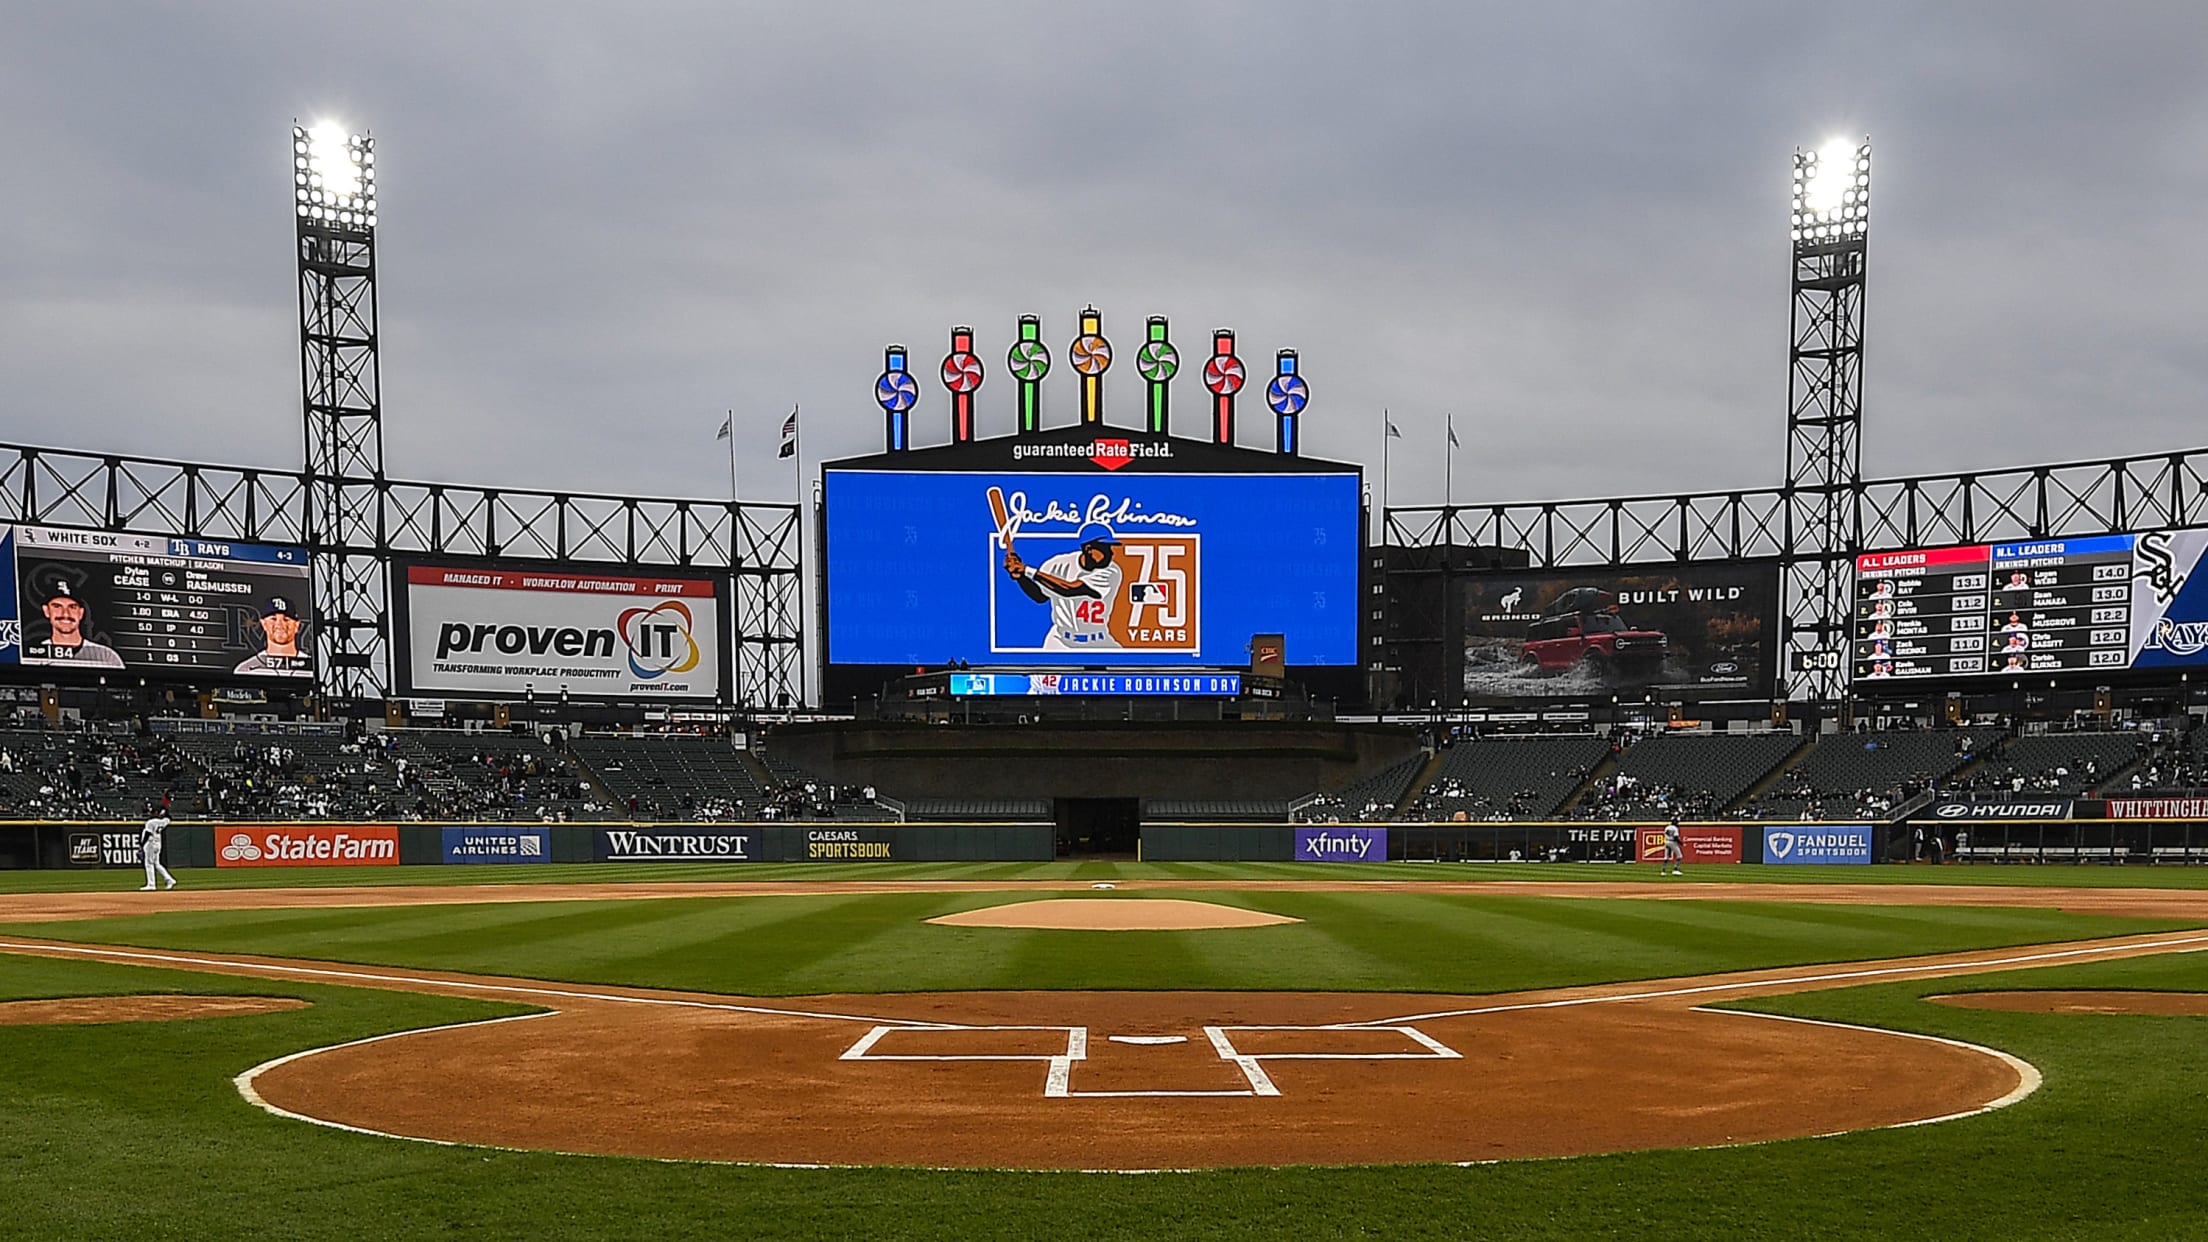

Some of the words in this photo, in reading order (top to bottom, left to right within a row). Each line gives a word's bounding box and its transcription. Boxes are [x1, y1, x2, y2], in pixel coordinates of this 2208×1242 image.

[1013, 443, 1094, 459] guaranteed
[1095, 442, 1128, 457] Rate
[1129, 442, 1174, 457] Field.
[1000, 492, 1081, 548] Jackie
[1085, 494, 1197, 526] Robinson
[48, 531, 88, 544] WHITE
[92, 535, 117, 547] SOX
[134, 540, 150, 549] 4-2
[197, 543, 229, 555] RAYS
[2018, 543, 2065, 555] LEADERS
[110, 554, 145, 564] PITCHER
[146, 557, 186, 567] MATCHUP
[194, 561, 224, 570] SEASON
[277, 552, 293, 561] 4-3
[1883, 554, 1926, 566] LEADERS
[2031, 557, 2064, 567] PITCHED
[124, 567, 149, 576] Dylan
[1894, 567, 1926, 577] PITCHED
[2099, 568, 2125, 578] 14.0
[114, 575, 150, 586] CEASE
[443, 573, 491, 585] MANAGED
[493, 576, 503, 586] IT
[522, 577, 576, 590] WORKFLOW
[577, 580, 636, 592] AUTOMATION
[654, 583, 683, 594] PRINT
[1958, 578, 1982, 588] 13.1
[186, 581, 252, 594] RASMUSSEN
[1125, 545, 1186, 628] 75
[137, 592, 151, 600] 1-0
[189, 596, 204, 604] 0-0
[1618, 590, 1678, 604] BUILT
[2096, 589, 2124, 600] 13.0
[1956, 599, 1981, 608] 11.2
[161, 609, 180, 619] ERA
[1076, 600, 1105, 624] 42
[1481, 613, 1541, 621] BRONCO
[2096, 611, 2122, 621] 12.2
[138, 623, 153, 632] 5.0
[166, 623, 176, 633] IP
[190, 625, 204, 634] 4.0
[1955, 619, 1980, 629] 11.1
[435, 621, 616, 660] proven
[639, 624, 677, 658] IT
[1128, 629, 1187, 642] YEARS
[2095, 632, 2122, 642] 12.0
[147, 638, 152, 646] 1
[191, 640, 197, 649] 1
[1954, 640, 1980, 649] 11.0
[54, 646, 74, 658] 84
[147, 653, 153, 661] 1
[192, 655, 197, 664] 1
[266, 658, 282, 668] 57
[1802, 652, 1838, 669] 6:00
[2094, 653, 2121, 664] 12.0
[1954, 660, 1979, 670] 10.2
[433, 663, 503, 675] TRANSFORMING
[504, 666, 558, 677] WORKPLACE
[560, 668, 621, 679] PRODUCTIVITY
[1042, 675, 1057, 687] 42
[1063, 678, 1116, 692] JACKIE
[1125, 678, 1201, 692] ROBINSON
[1210, 678, 1238, 692] DAY
[629, 682, 689, 692] provenIT.com
[1971, 805, 2062, 816] HYUNDAI
[2111, 799, 2208, 818] WHITTINGHA
[102, 833, 140, 849] STRE
[465, 837, 517, 845] UNITED
[808, 831, 858, 841] CAESARS
[1568, 829, 1600, 842] THE
[1644, 835, 1666, 846] CIB
[1797, 834, 1867, 847] FANDUEL
[264, 833, 331, 860] State
[332, 834, 394, 859] Farm
[606, 831, 748, 855] WINTRUST
[1306, 831, 1373, 858] xfinity
[452, 846, 517, 855] AIRLINES
[809, 842, 891, 858] SPORTSBOOK
[1797, 848, 1867, 856] SPORTSBOOK
